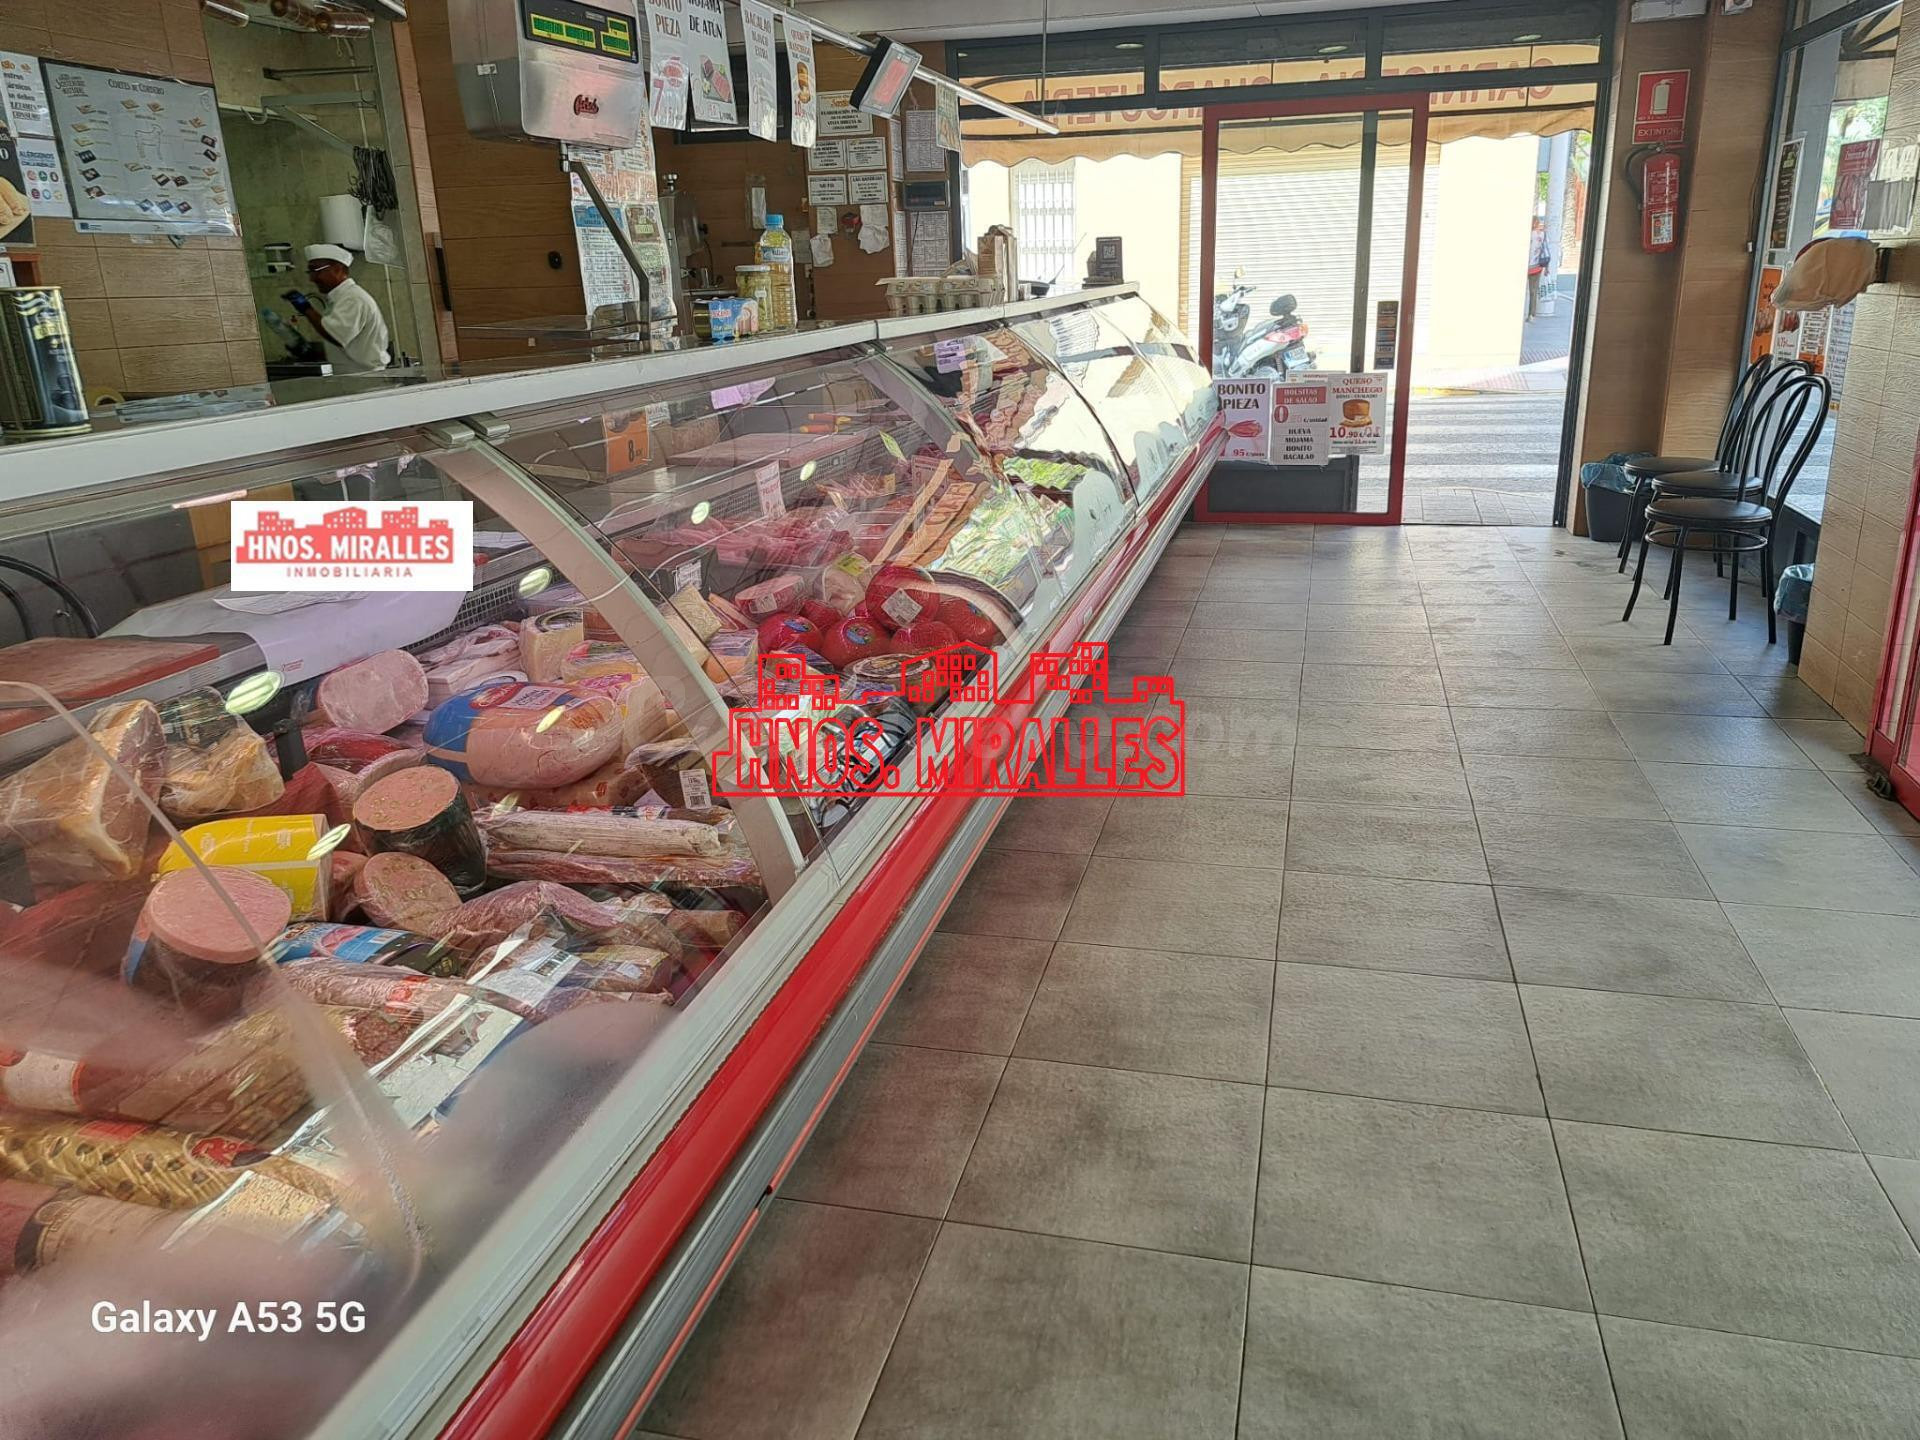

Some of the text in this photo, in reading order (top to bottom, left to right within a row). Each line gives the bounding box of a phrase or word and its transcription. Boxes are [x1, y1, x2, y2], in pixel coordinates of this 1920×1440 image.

[655, 13, 681, 38] PIEZA
[689, 14, 701, 33] DE
[1343, 377, 1373, 386] QUESO
[1217, 383, 1266, 395] BONITO
[1332, 386, 1383, 394] MANCHEGO
[1223, 398, 1259, 410] PIEZA
